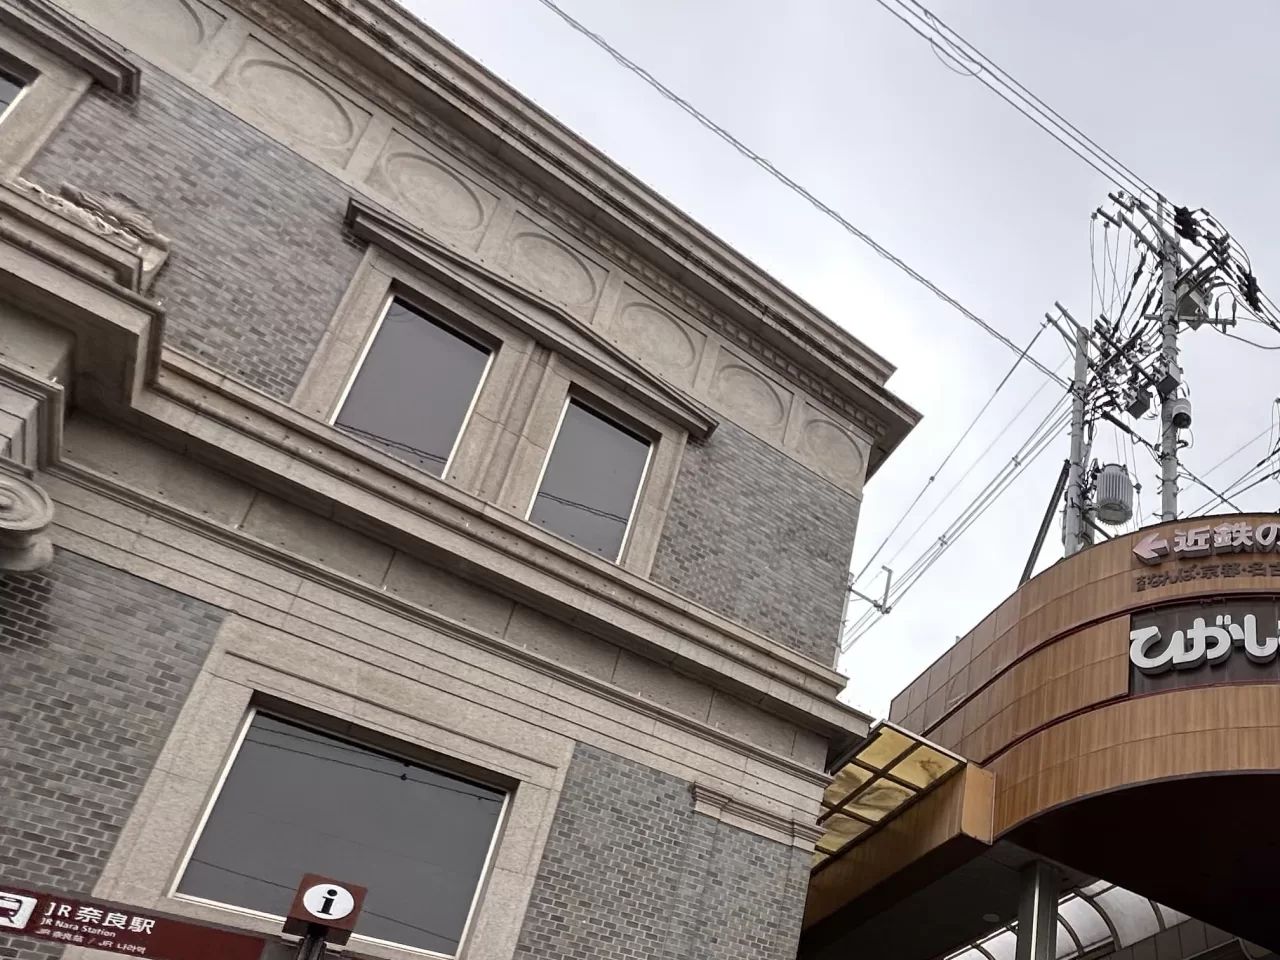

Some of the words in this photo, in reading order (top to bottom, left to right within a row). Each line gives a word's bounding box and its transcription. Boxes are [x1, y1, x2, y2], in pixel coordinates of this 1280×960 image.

[40, 917, 53, 926] JR
[55, 920, 79, 931] Nara
[81, 925, 116, 938] Station
[98, 940, 113, 948] JR
